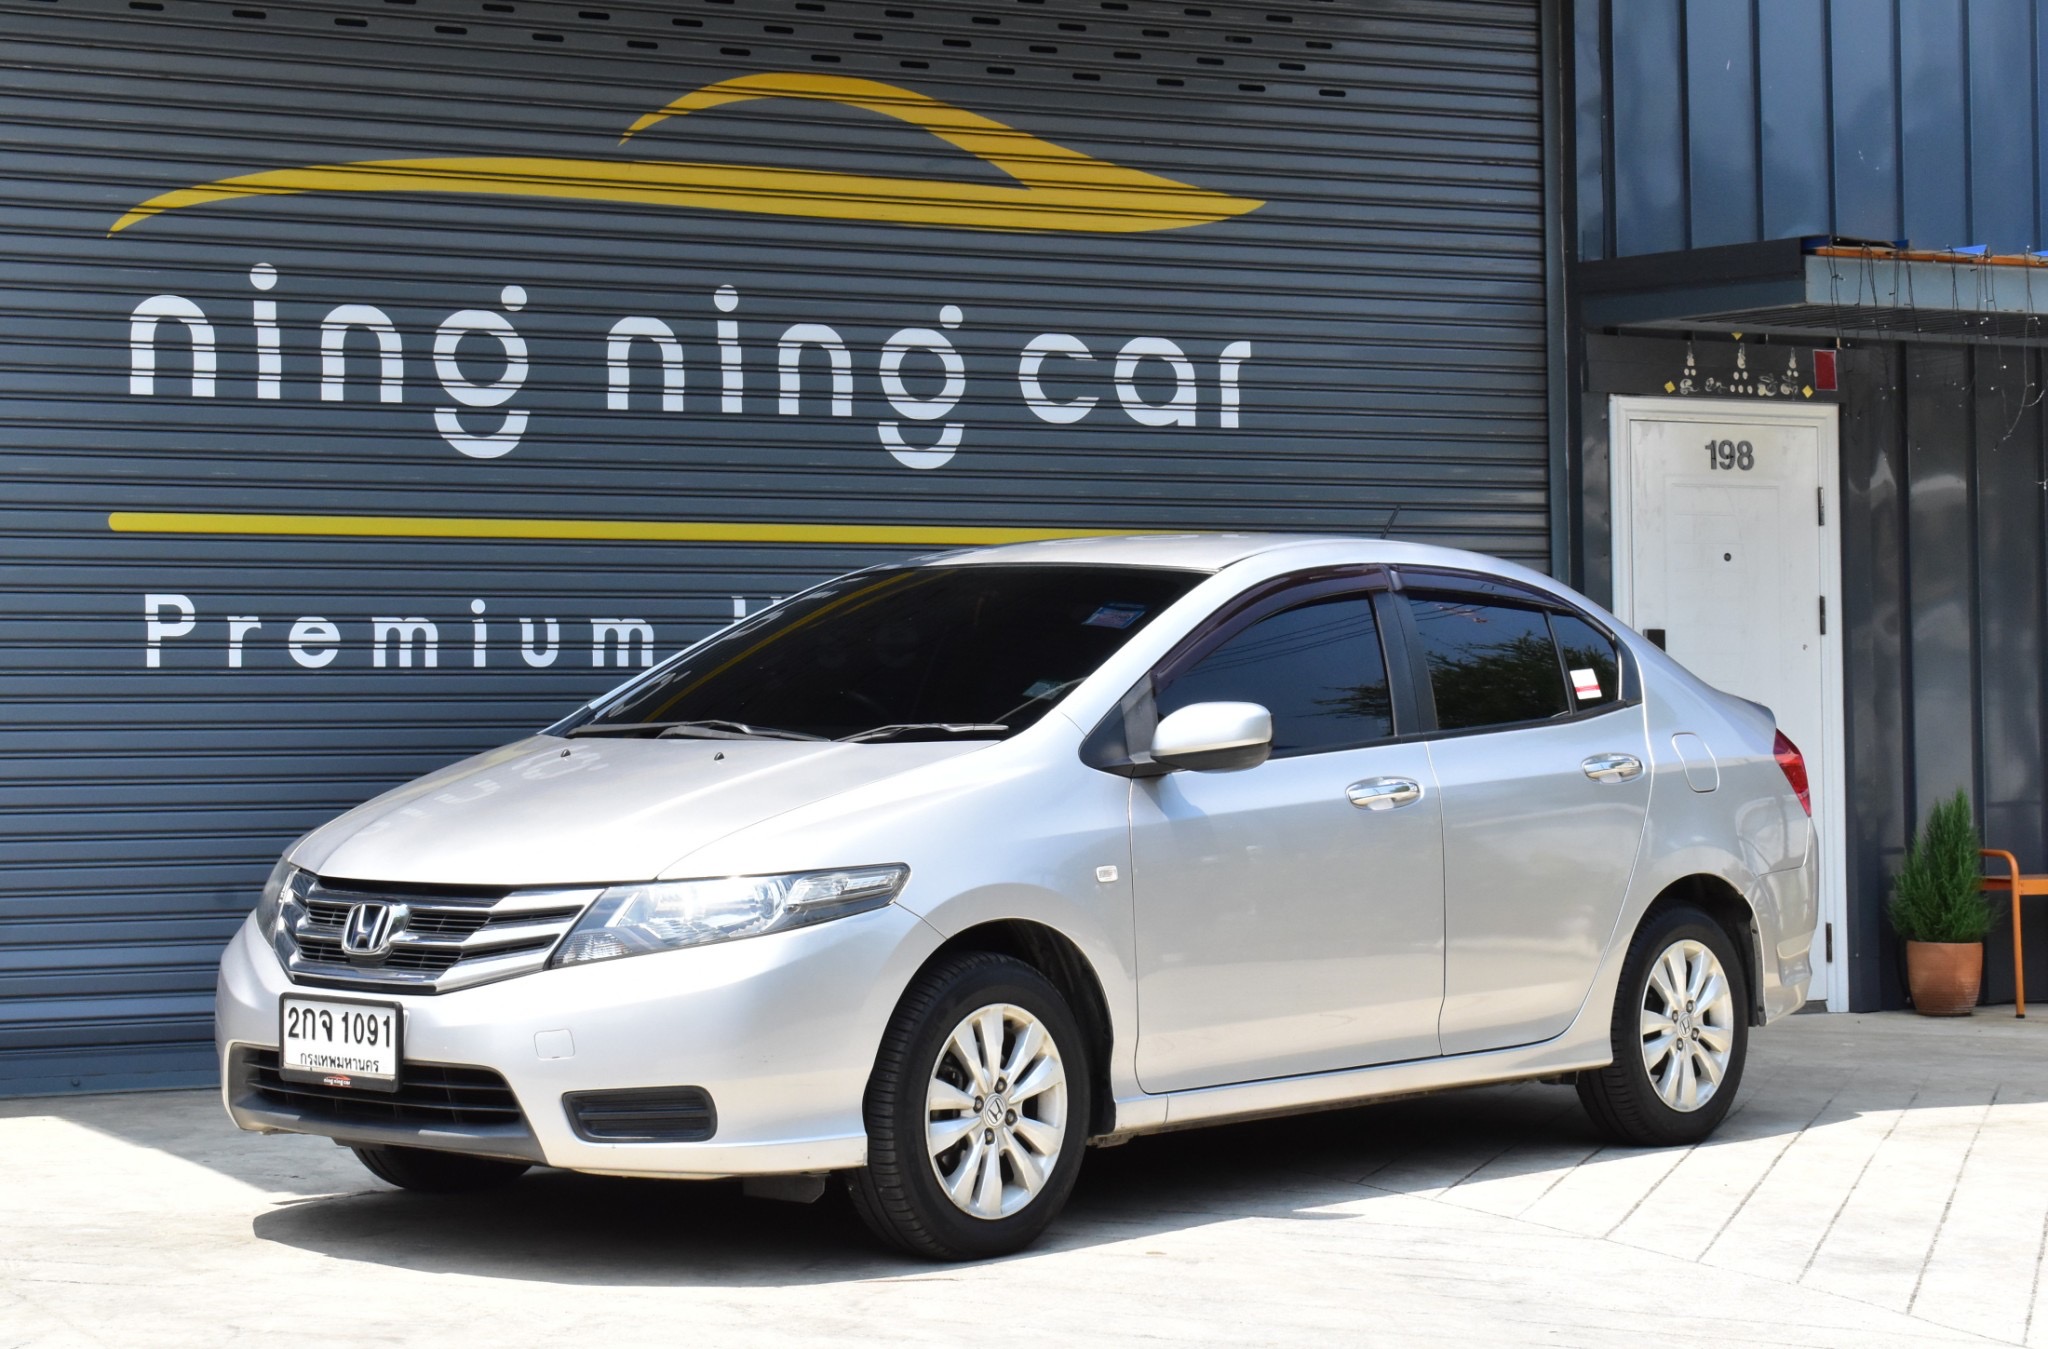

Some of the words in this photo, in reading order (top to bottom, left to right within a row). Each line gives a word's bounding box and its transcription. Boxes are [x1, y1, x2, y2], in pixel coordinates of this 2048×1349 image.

[130, 262, 530, 459] ning
[606, 284, 967, 470] ning
[1018, 333, 1252, 429] car
[1704, 439, 1755, 471] 198
[144, 594, 655, 668] Premium
[288, 1006, 333, 1042] 2กจ
[341, 1011, 391, 1048] 1091
